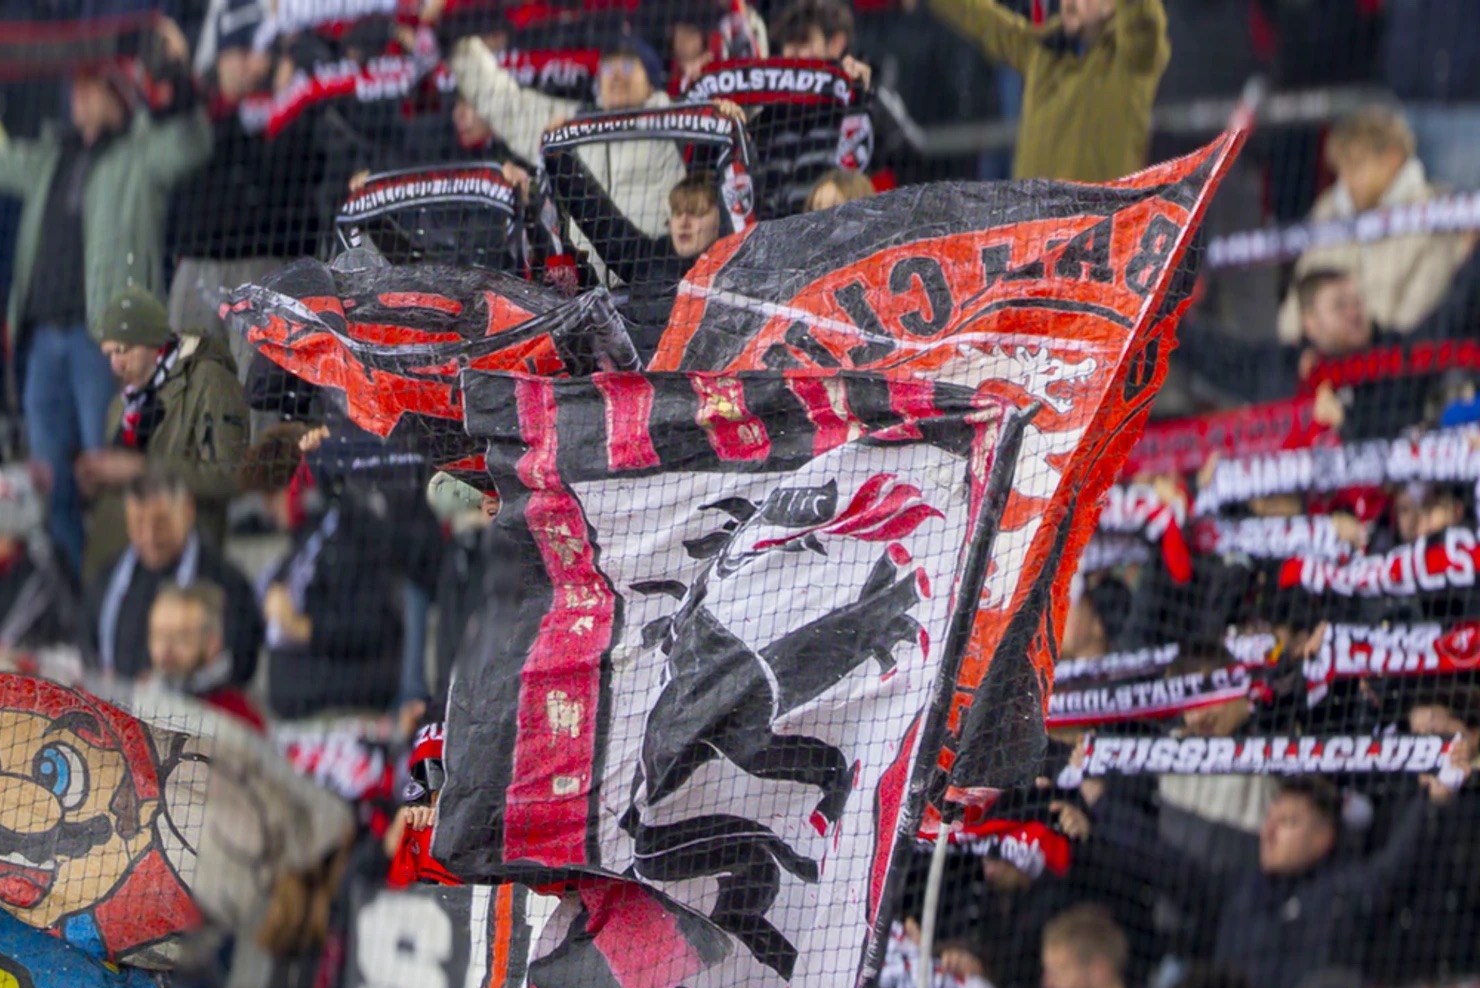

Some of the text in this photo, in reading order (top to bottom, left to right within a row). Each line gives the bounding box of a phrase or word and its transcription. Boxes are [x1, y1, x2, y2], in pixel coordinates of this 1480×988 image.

[687, 68, 833, 103] NGOLSTADT
[1048, 671, 1205, 713] NGOLSTADT
[1089, 735, 1444, 775] FUSSBALLCLUB
